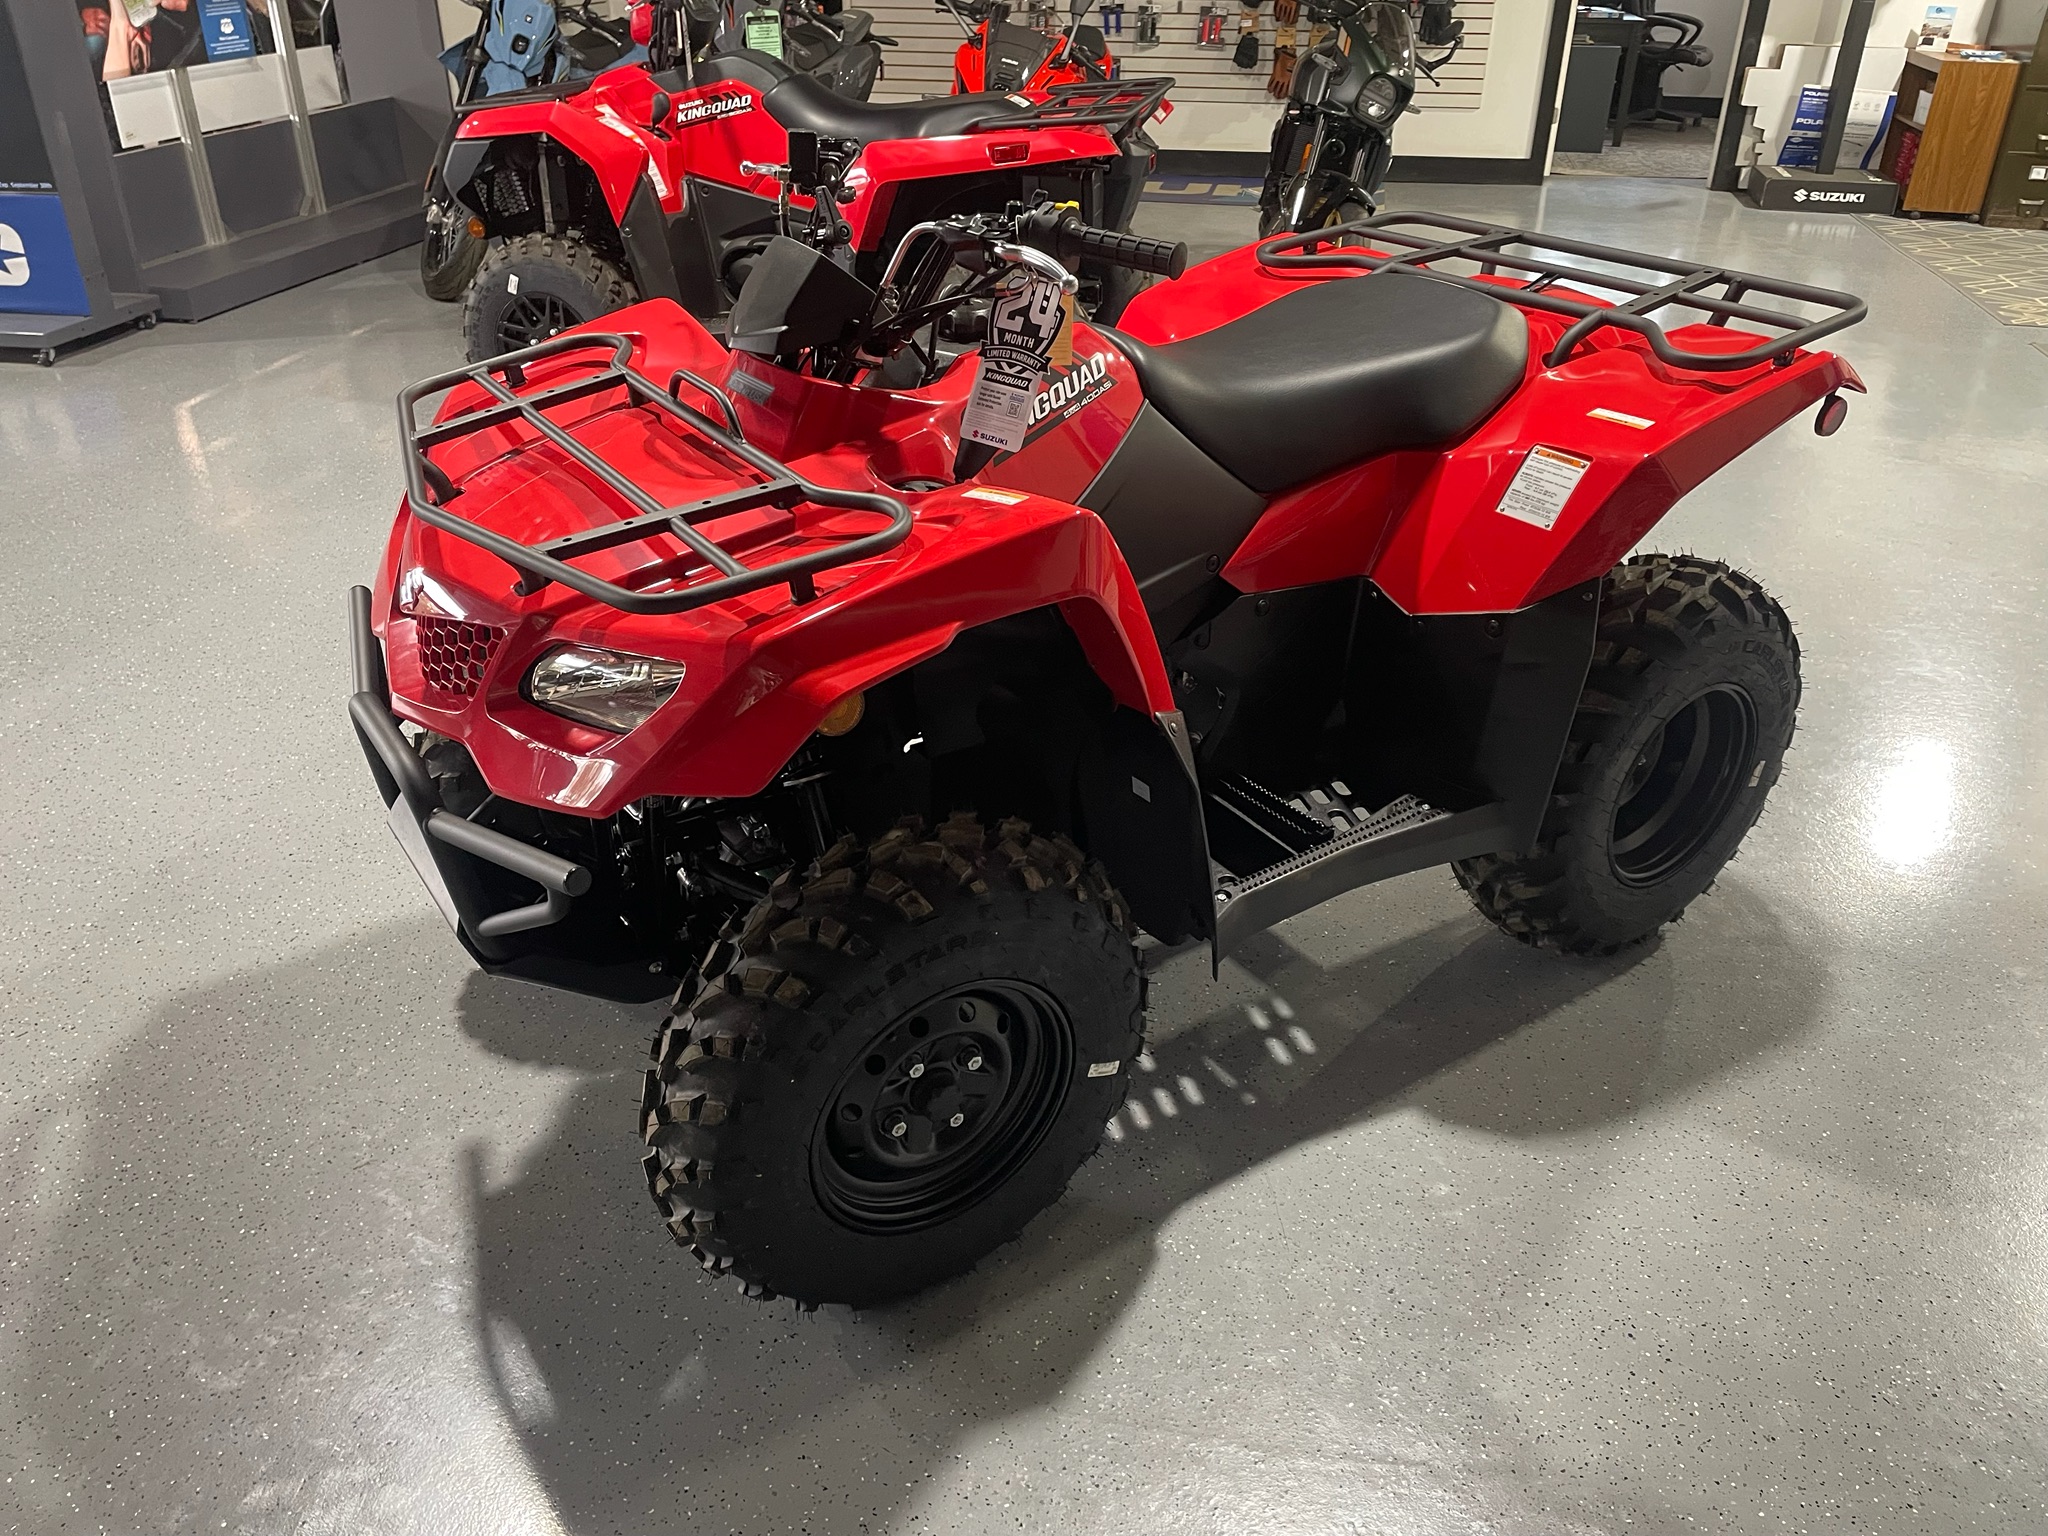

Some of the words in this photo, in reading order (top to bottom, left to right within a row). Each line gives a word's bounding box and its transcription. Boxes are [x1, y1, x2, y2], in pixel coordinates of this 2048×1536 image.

[677, 94, 752, 123] KINGQUAD
[1809, 191, 1866, 203] SUZUKI
[995, 277, 1061, 339] 24
[1003, 331, 1035, 349] MONTH
[986, 349, 1011, 358] LIMITED
[1011, 350, 1042, 370] WARRANTY
[986, 371, 1029, 388] KINGQUAD
[980, 432, 1008, 446] SUZUKI
